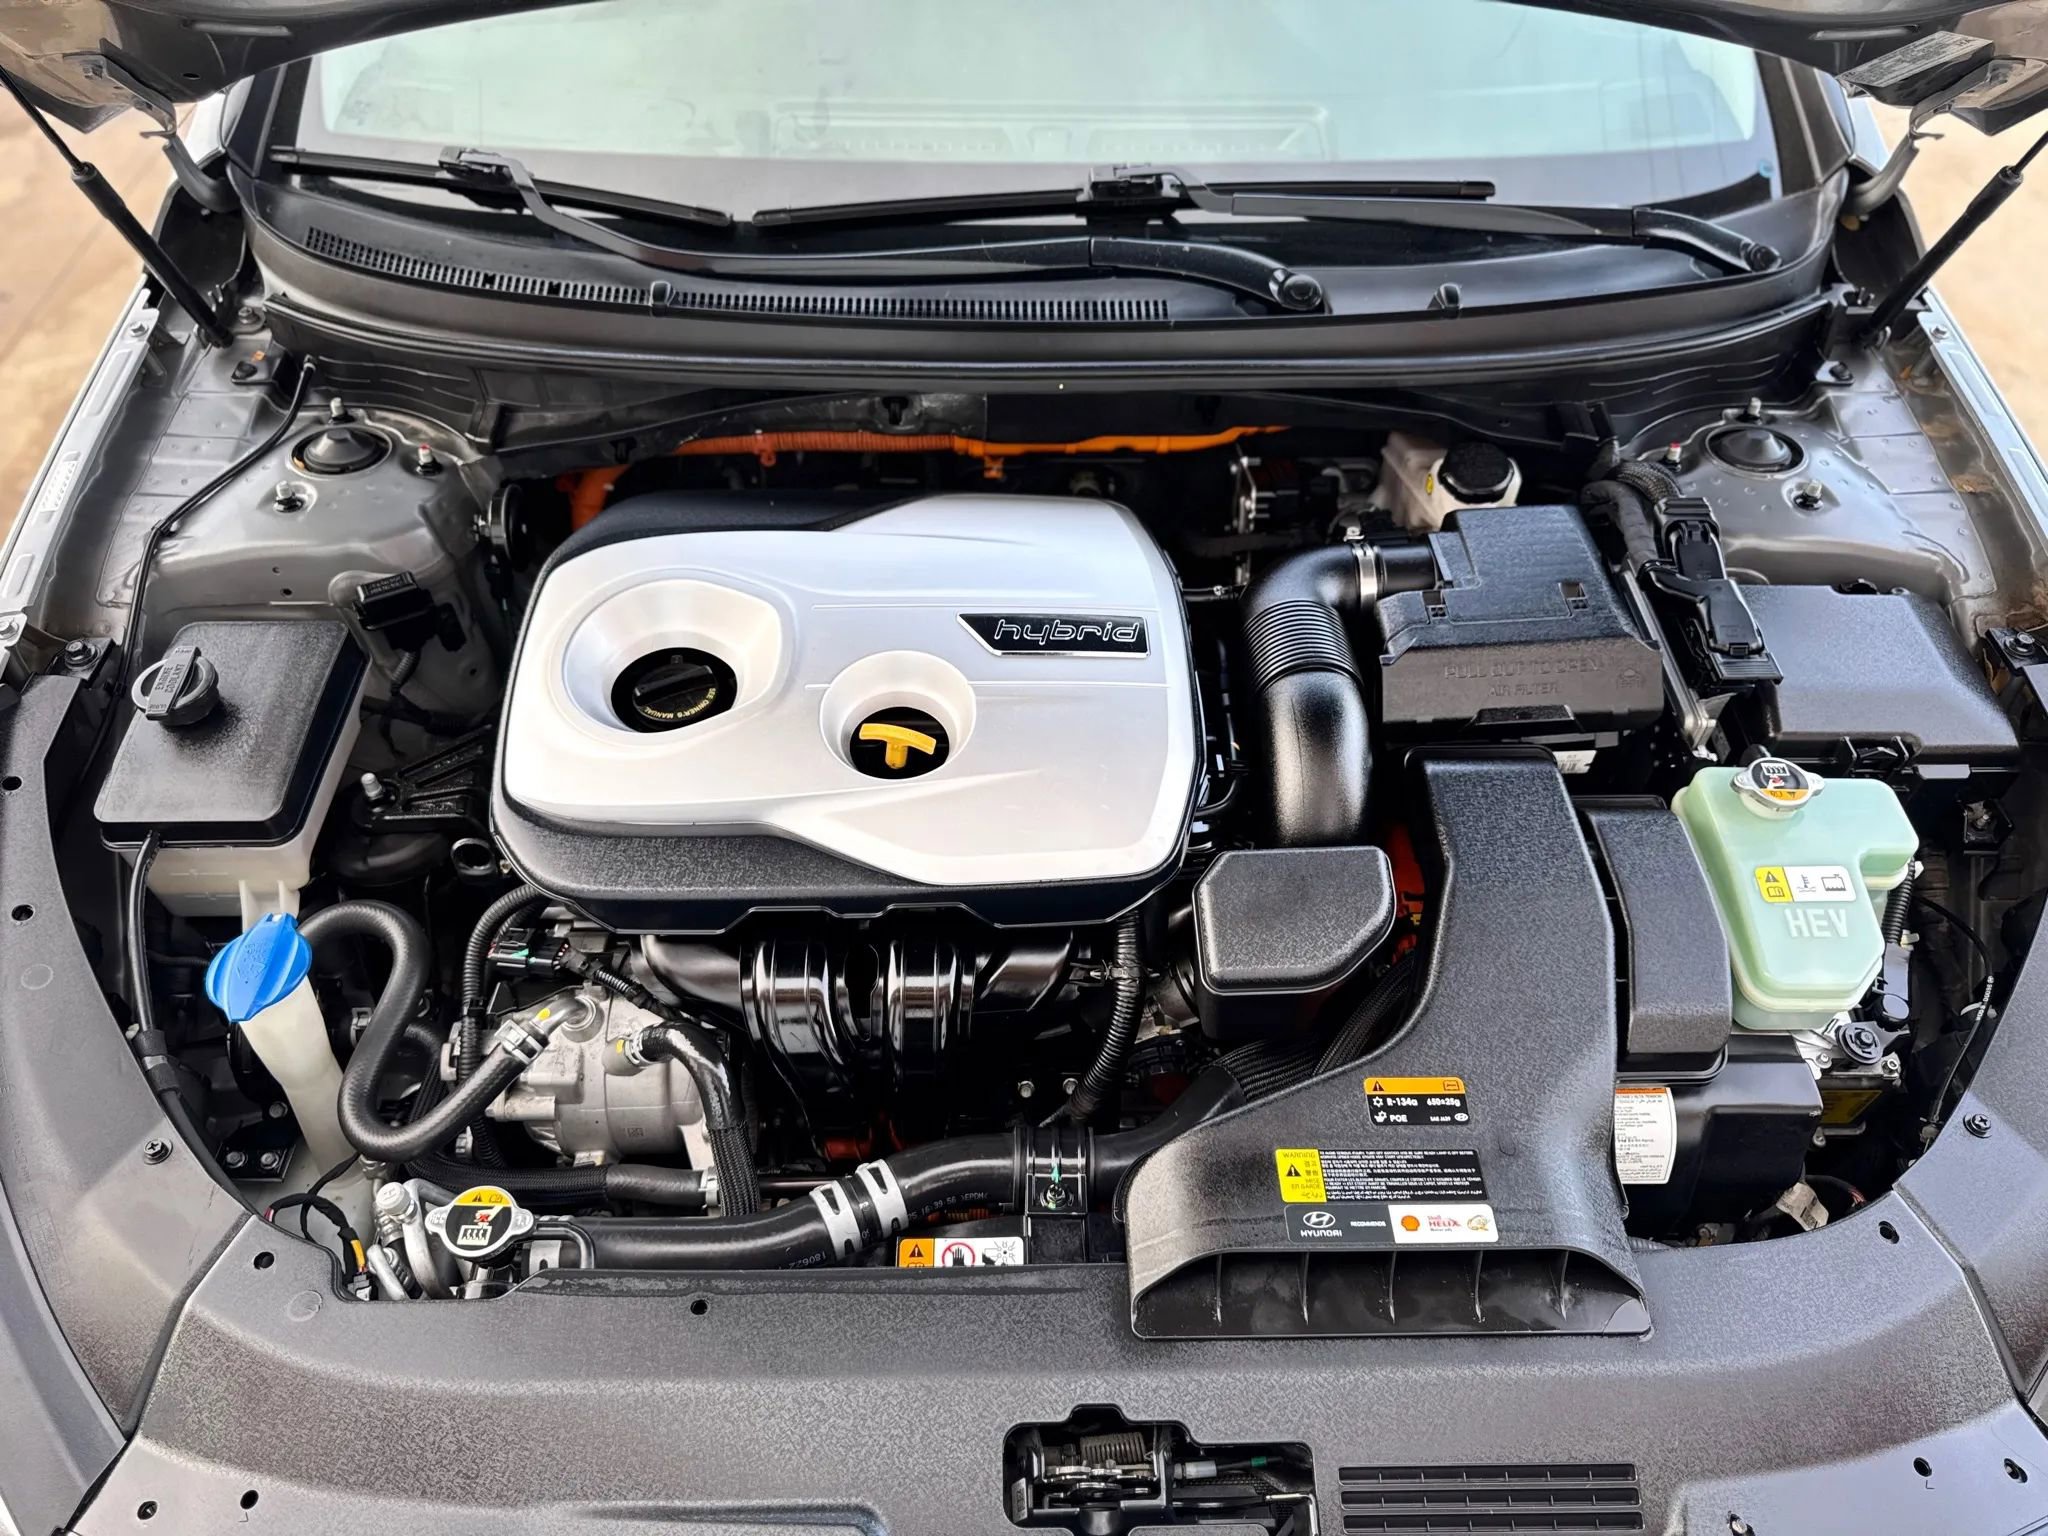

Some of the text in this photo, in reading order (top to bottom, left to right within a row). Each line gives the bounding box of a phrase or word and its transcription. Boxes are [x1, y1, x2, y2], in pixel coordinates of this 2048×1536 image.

[994, 619, 1140, 645] hybrid
[1443, 657, 1599, 679] PULL OUT TO OPEN
[165, 664, 185, 693] COOLANT
[1487, 681, 1559, 697] AIR FILTER
[643, 688, 716, 719] SEE OWNER'S MANUAL
[1784, 908, 1848, 938] HEV
[1386, 1097, 1418, 1106] R-134a
[1389, 1114, 1408, 1122] POE
[1428, 1219, 1461, 1228] HELIX
[1300, 1229, 1342, 1238] HYUNDAI
